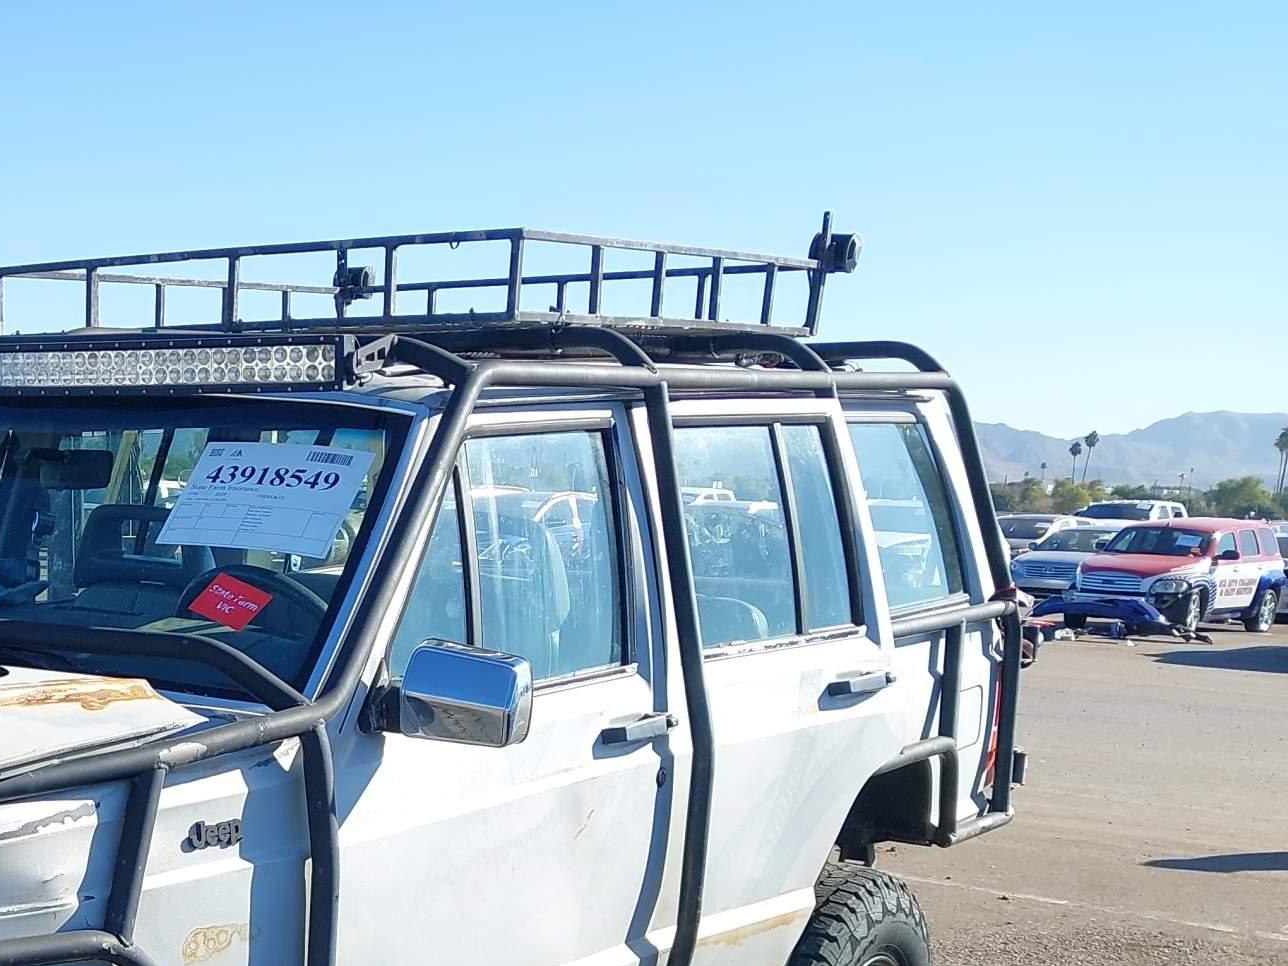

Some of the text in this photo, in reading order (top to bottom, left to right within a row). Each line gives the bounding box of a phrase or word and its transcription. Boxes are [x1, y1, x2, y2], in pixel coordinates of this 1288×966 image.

[206, 464, 340, 491] 43918549
[209, 585, 258, 612] State Farm
[189, 819, 242, 849] Jeep
